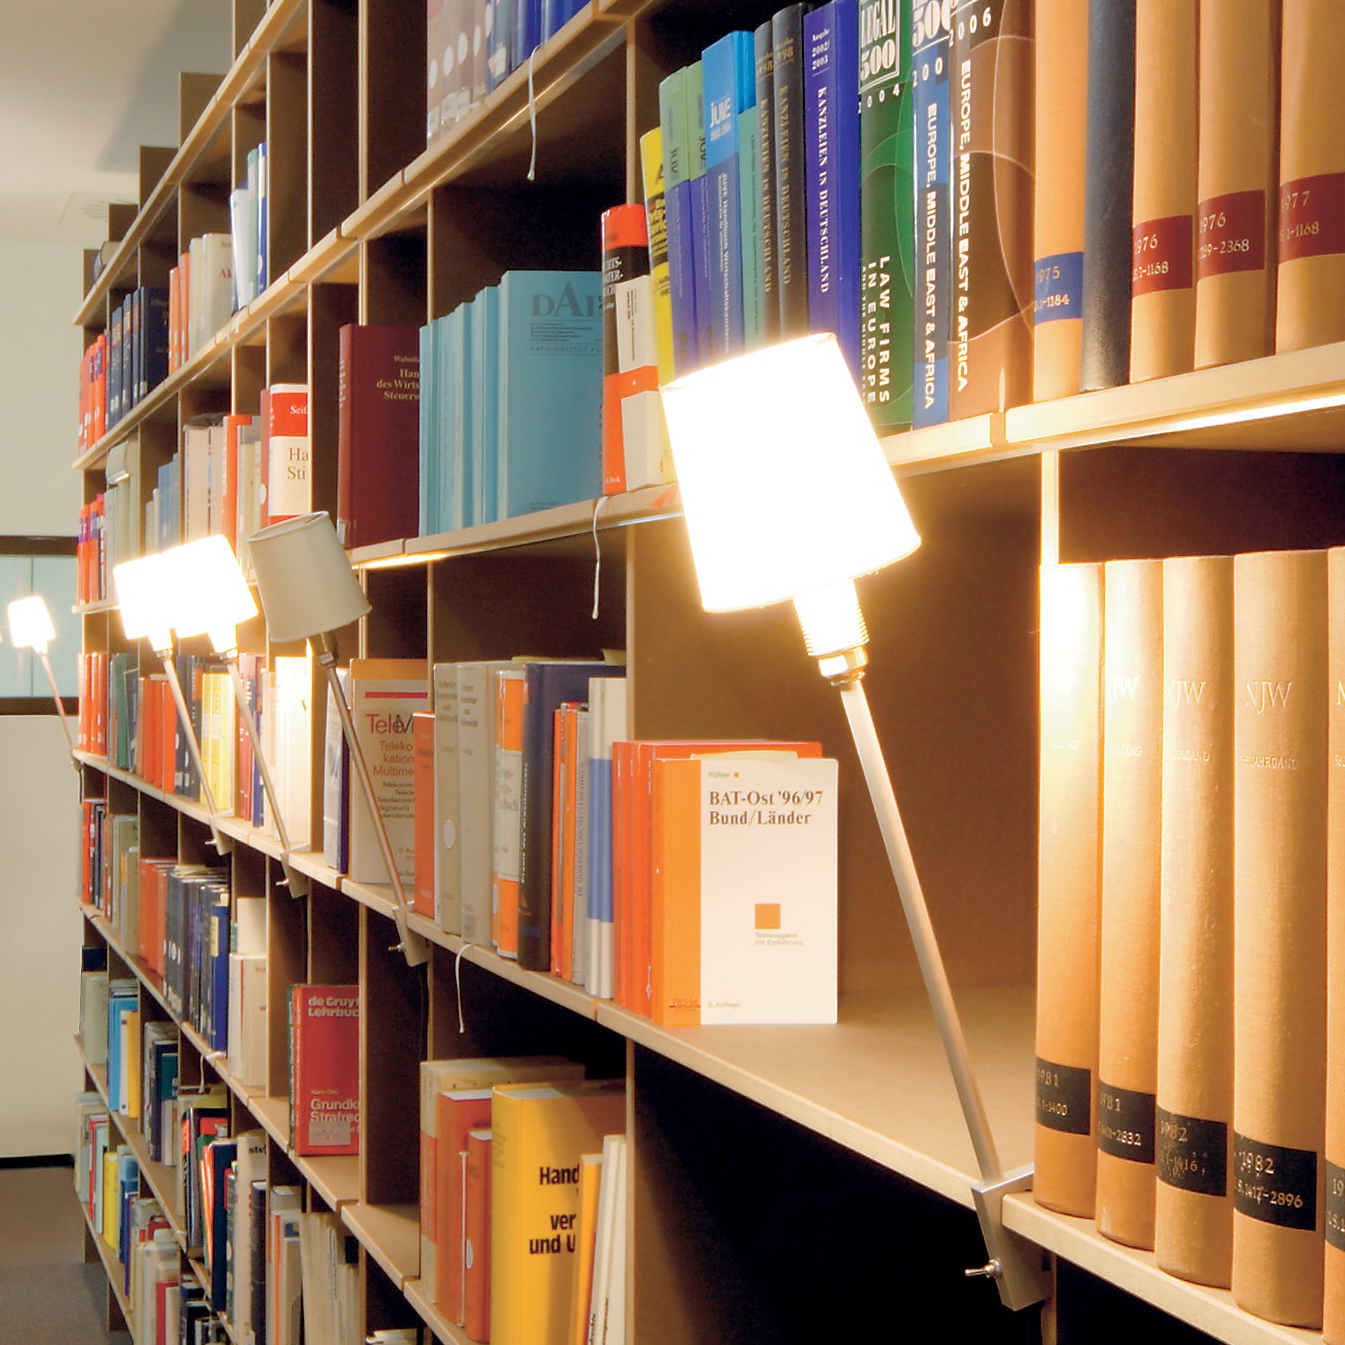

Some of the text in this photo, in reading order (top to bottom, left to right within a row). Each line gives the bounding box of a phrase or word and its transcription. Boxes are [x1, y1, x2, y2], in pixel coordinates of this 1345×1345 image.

[949, 7, 991, 47] 2006
[860, 39, 895, 82] 500
[912, 56, 943, 88] 200
[818, 86, 830, 293] KANZLEIEN IN DEUTSCHLAND
[958, 60, 971, 392] EUROPE, MIDDLE EAST & AFRICA
[925, 103, 938, 409] EUROPE, MIDDLE EAST & AFRICA
[867, 262, 876, 403] IN EUROPE
[880, 256, 890, 402] LAW FIRMS
[400, 368, 419, 378] Han
[376, 379, 419, 389] des Wirts
[384, 391, 419, 400] Steuers
[289, 447, 308, 461] Ha
[287, 465, 306, 479] Sti
[1246, 681, 1292, 715] NJW
[379, 740, 413, 751] Teleko
[383, 754, 413, 764] kation
[373, 766, 413, 776] Multime
[709, 790, 774, 806] BAT-Ost
[709, 810, 811, 826] Bund/Länder
[308, 996, 359, 1008] de Gruyt
[308, 1008, 359, 1017] Lehrbuc
[310, 1098, 359, 1111] Grundk
[310, 1111, 359, 1123] Strafrec
[1241, 1151, 1275, 1175] 1982
[539, 1163, 580, 1185] Hand
[550, 1214, 577, 1230] ver
[529, 1234, 576, 1255] und U
